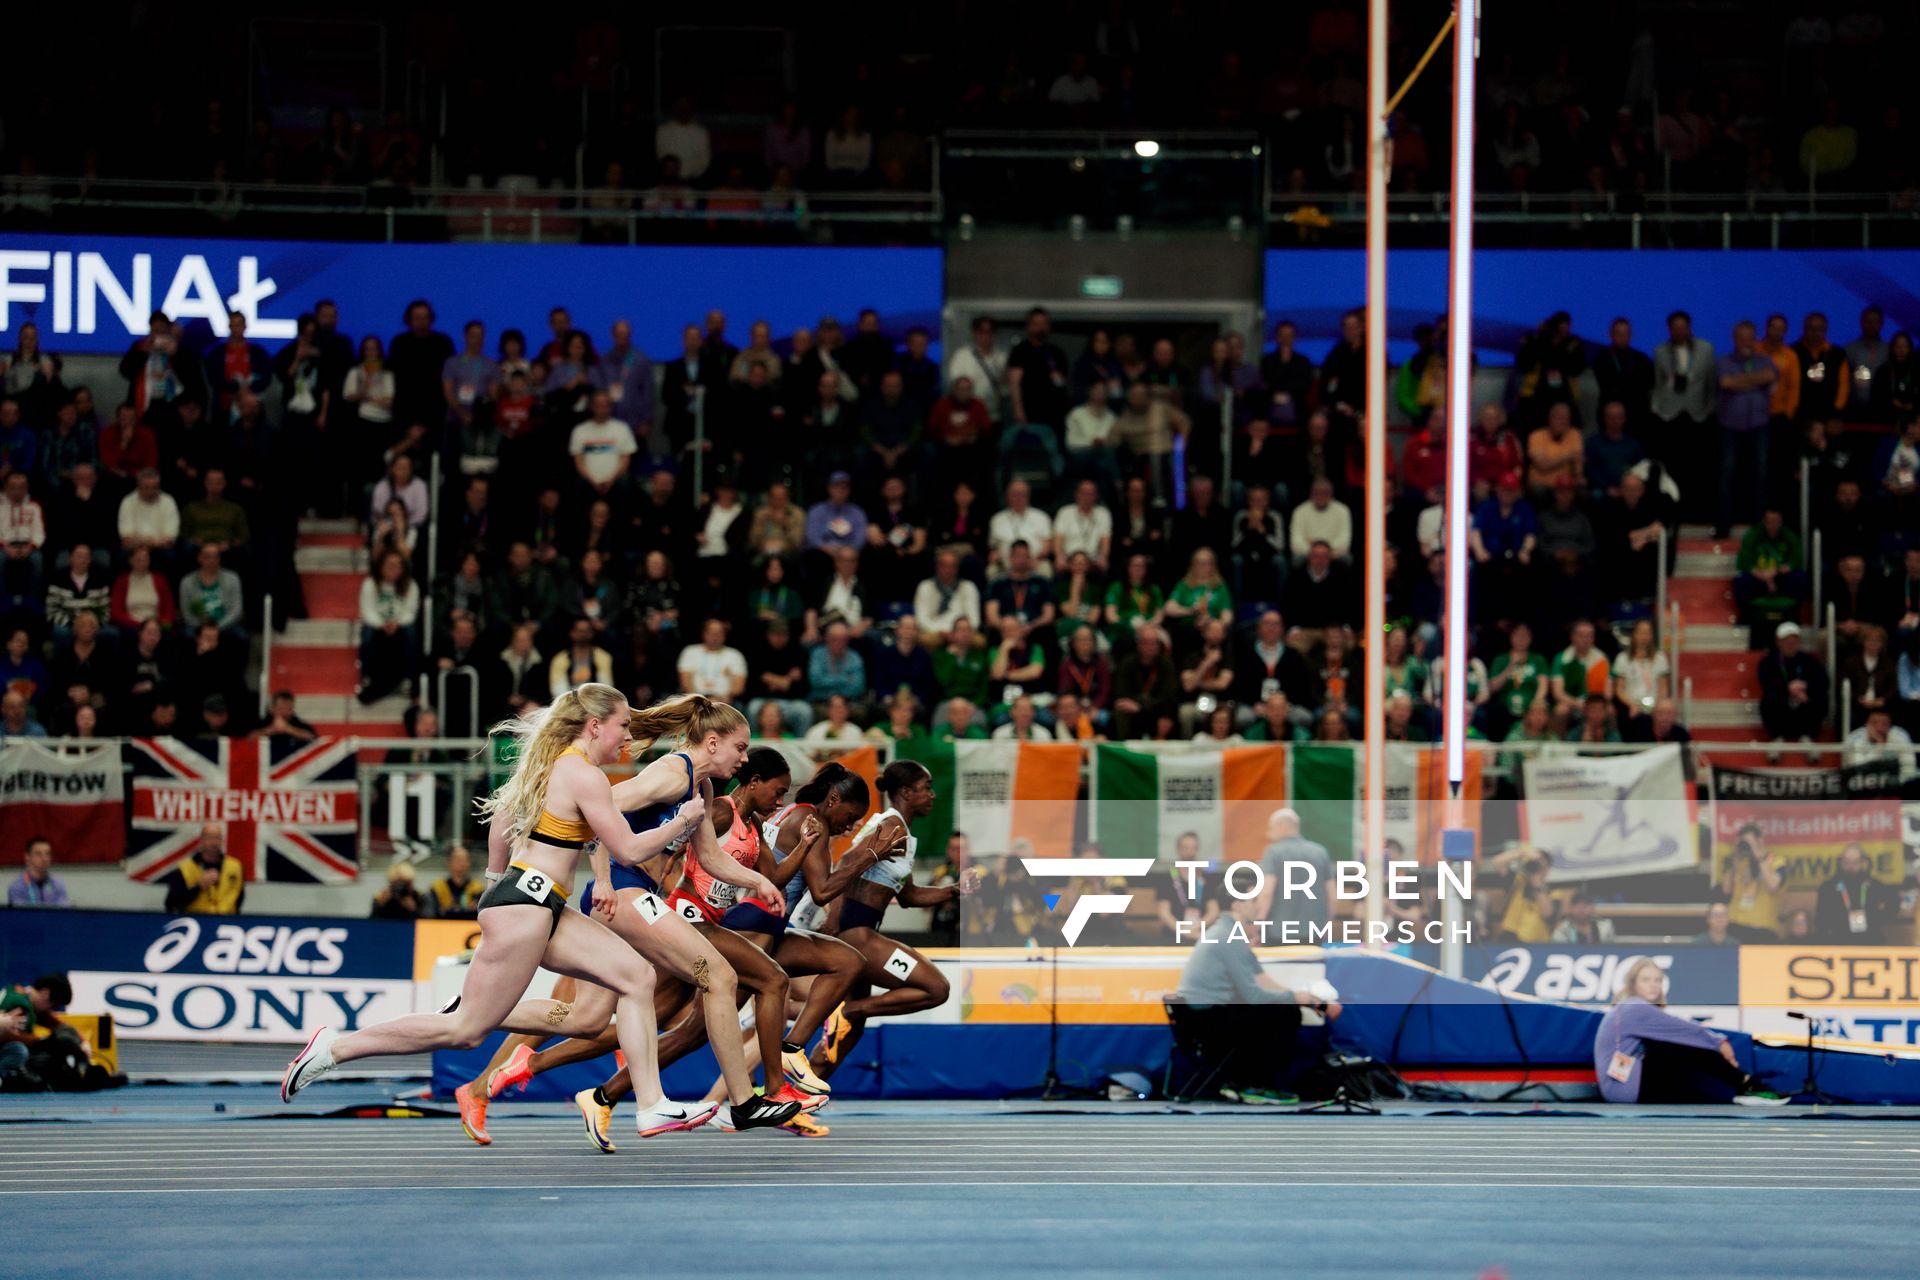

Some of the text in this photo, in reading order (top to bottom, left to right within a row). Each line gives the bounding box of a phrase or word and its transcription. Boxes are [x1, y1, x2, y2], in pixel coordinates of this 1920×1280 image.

[1719, 772, 1890, 795] FREUNDE der
[152, 789, 336, 823] WHITEHAVEN
[526, 875, 545, 892] 8
[641, 896, 658, 916] 7
[683, 905, 696, 918] 6
[892, 958, 909, 973] 3
[104, 982, 386, 1031] SONY
